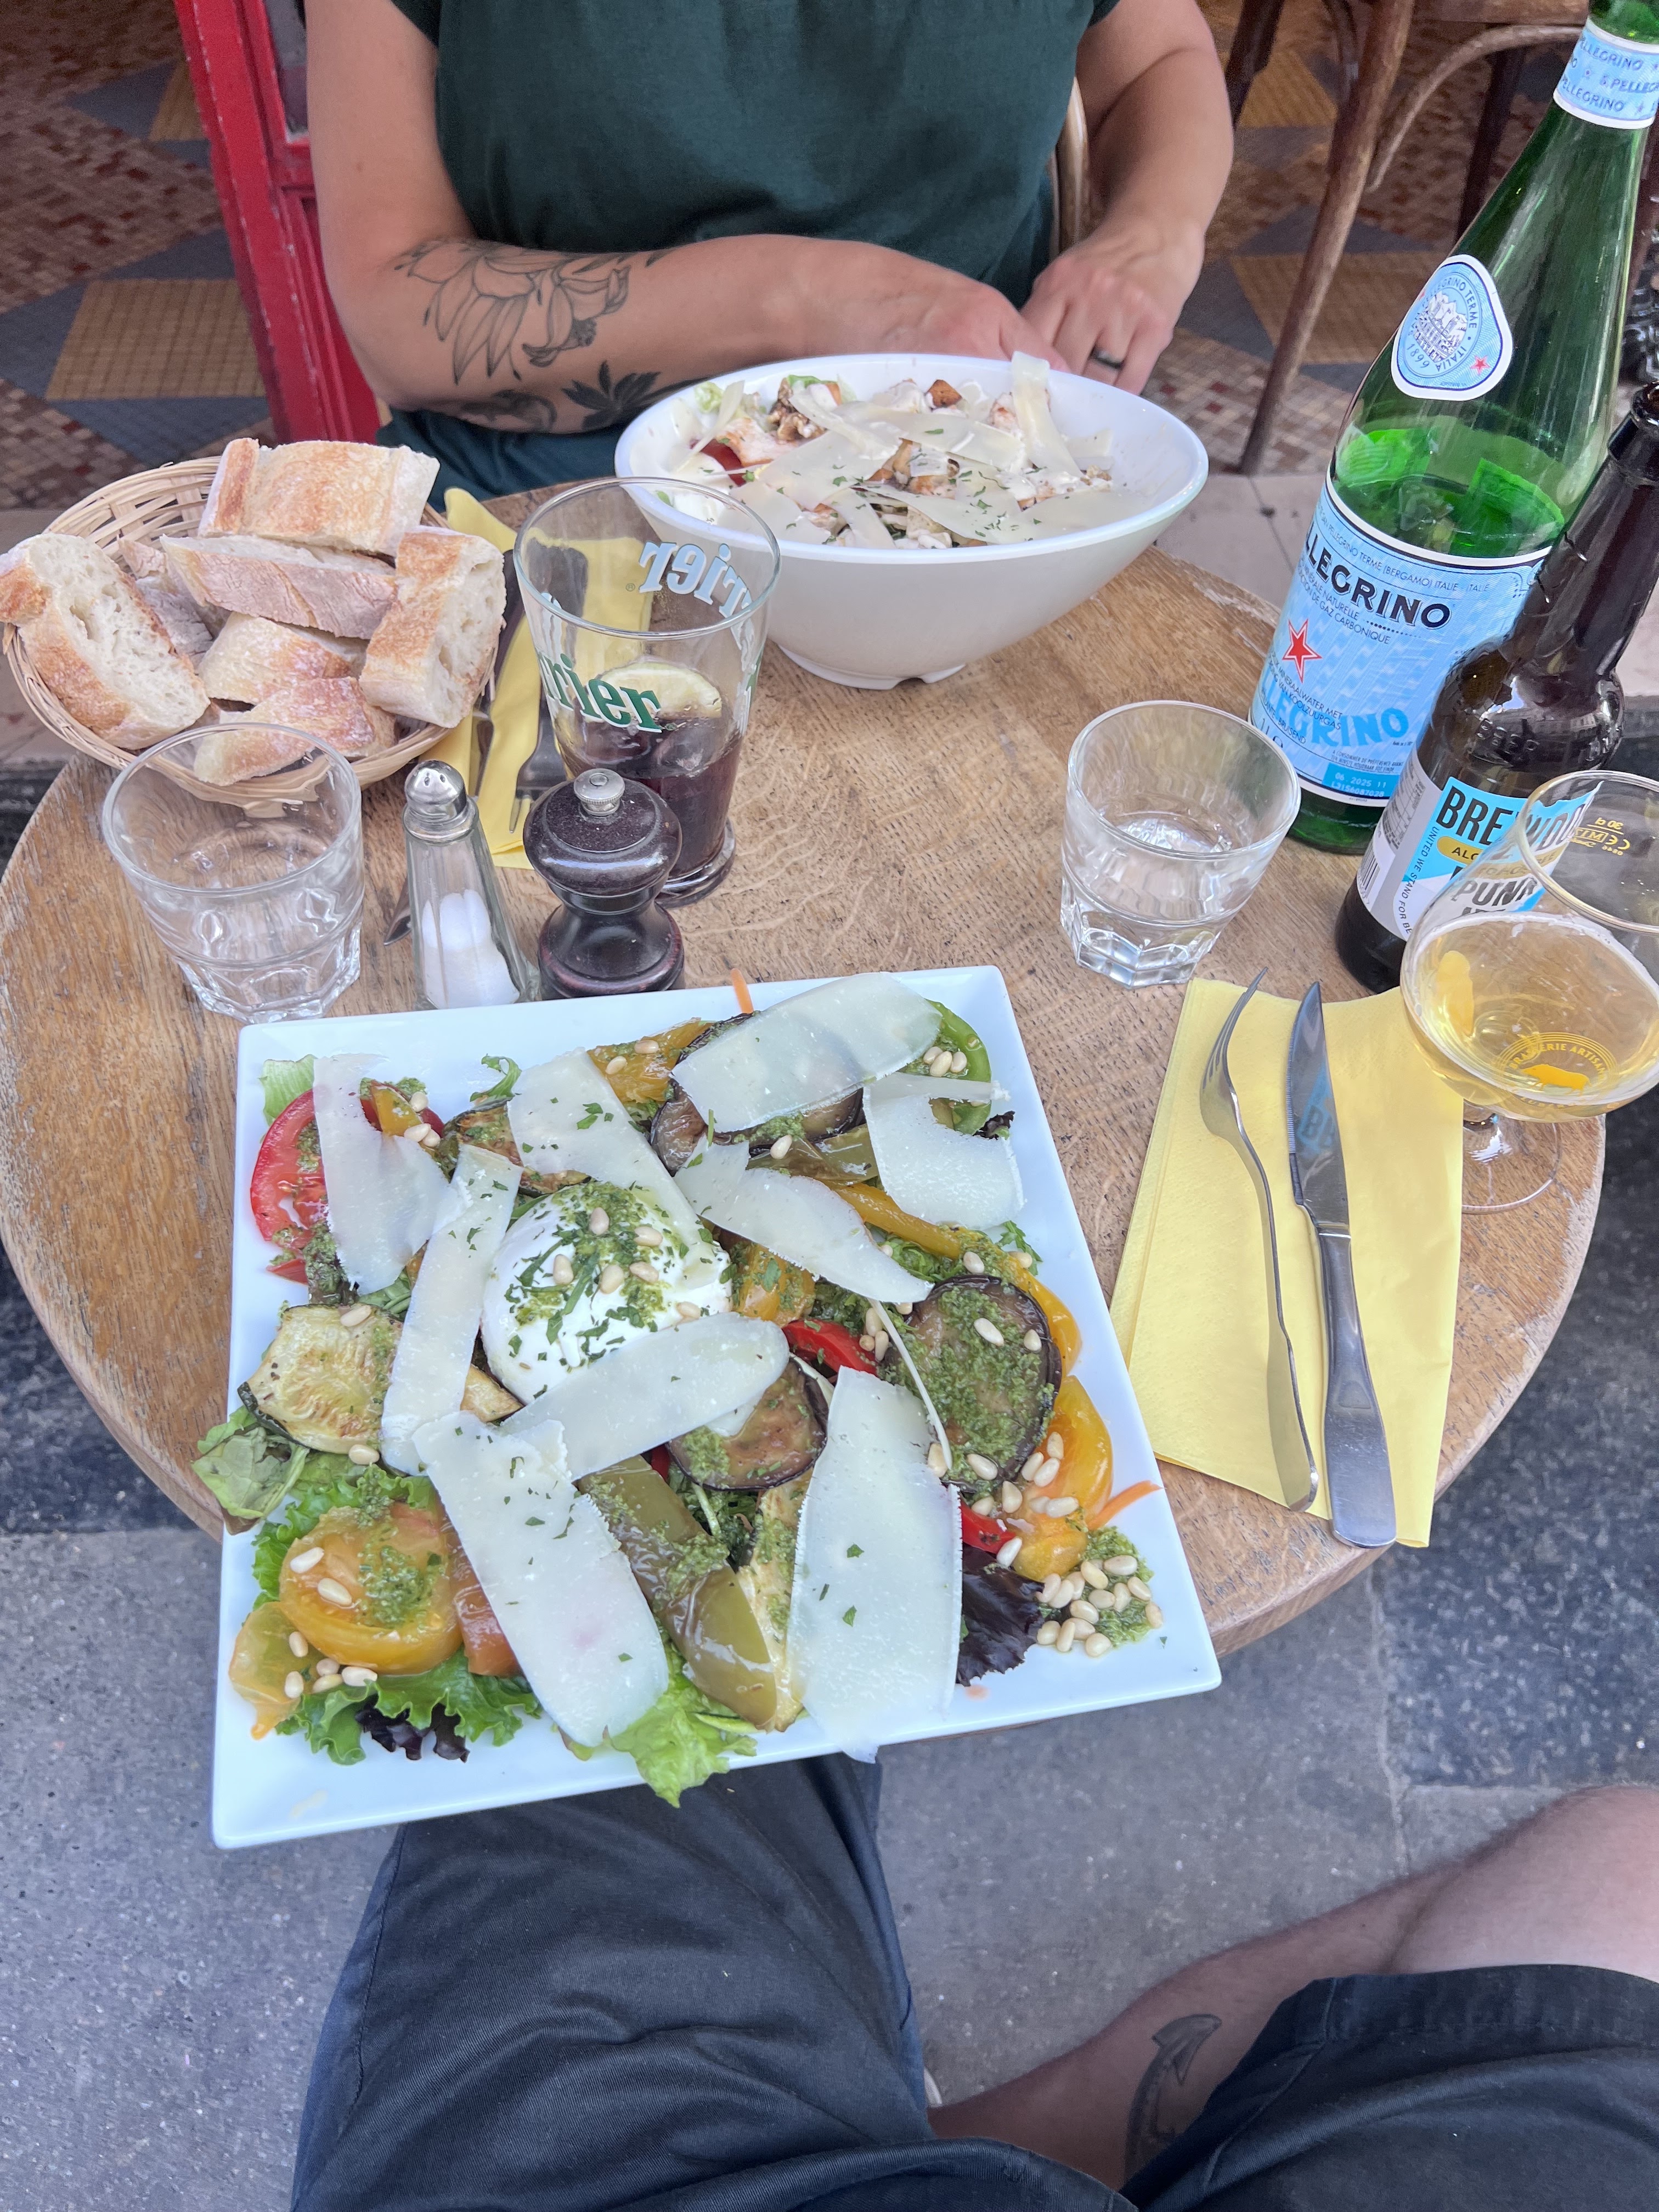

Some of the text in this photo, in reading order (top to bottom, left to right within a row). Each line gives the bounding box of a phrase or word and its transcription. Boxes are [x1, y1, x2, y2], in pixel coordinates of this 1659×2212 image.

[1465, 289, 1477, 329] TERME
[1407, 343, 1430, 369] 1899
[1435, 346, 1467, 373] ITALIA
[1325, 522, 1358, 556] PELLEGRINO
[1360, 551, 1382, 571] TERME
[1383, 565, 1432, 588] (BERGAMO)
[1435, 580, 1460, 592] ITALIE
[1323, 590, 1359, 621] NATURELLE
[1319, 601, 1334, 618] GAZ
[1334, 613, 1392, 645] CARBONIQUE
[1278, 679, 1342, 731] VAN KOOLZUURGAS
[1279, 666, 1325, 712] MINERAALWATER
[1325, 708, 1343, 720] MET
[1278, 717, 1306, 744] BRUISEND
[1350, 777, 1372, 787] 2025
[1421, 826, 1440, 858] UNITED
[1414, 858, 1426, 872] WE
[1401, 872, 1418, 899] STAND
[1398, 900, 1407, 919] FOR
